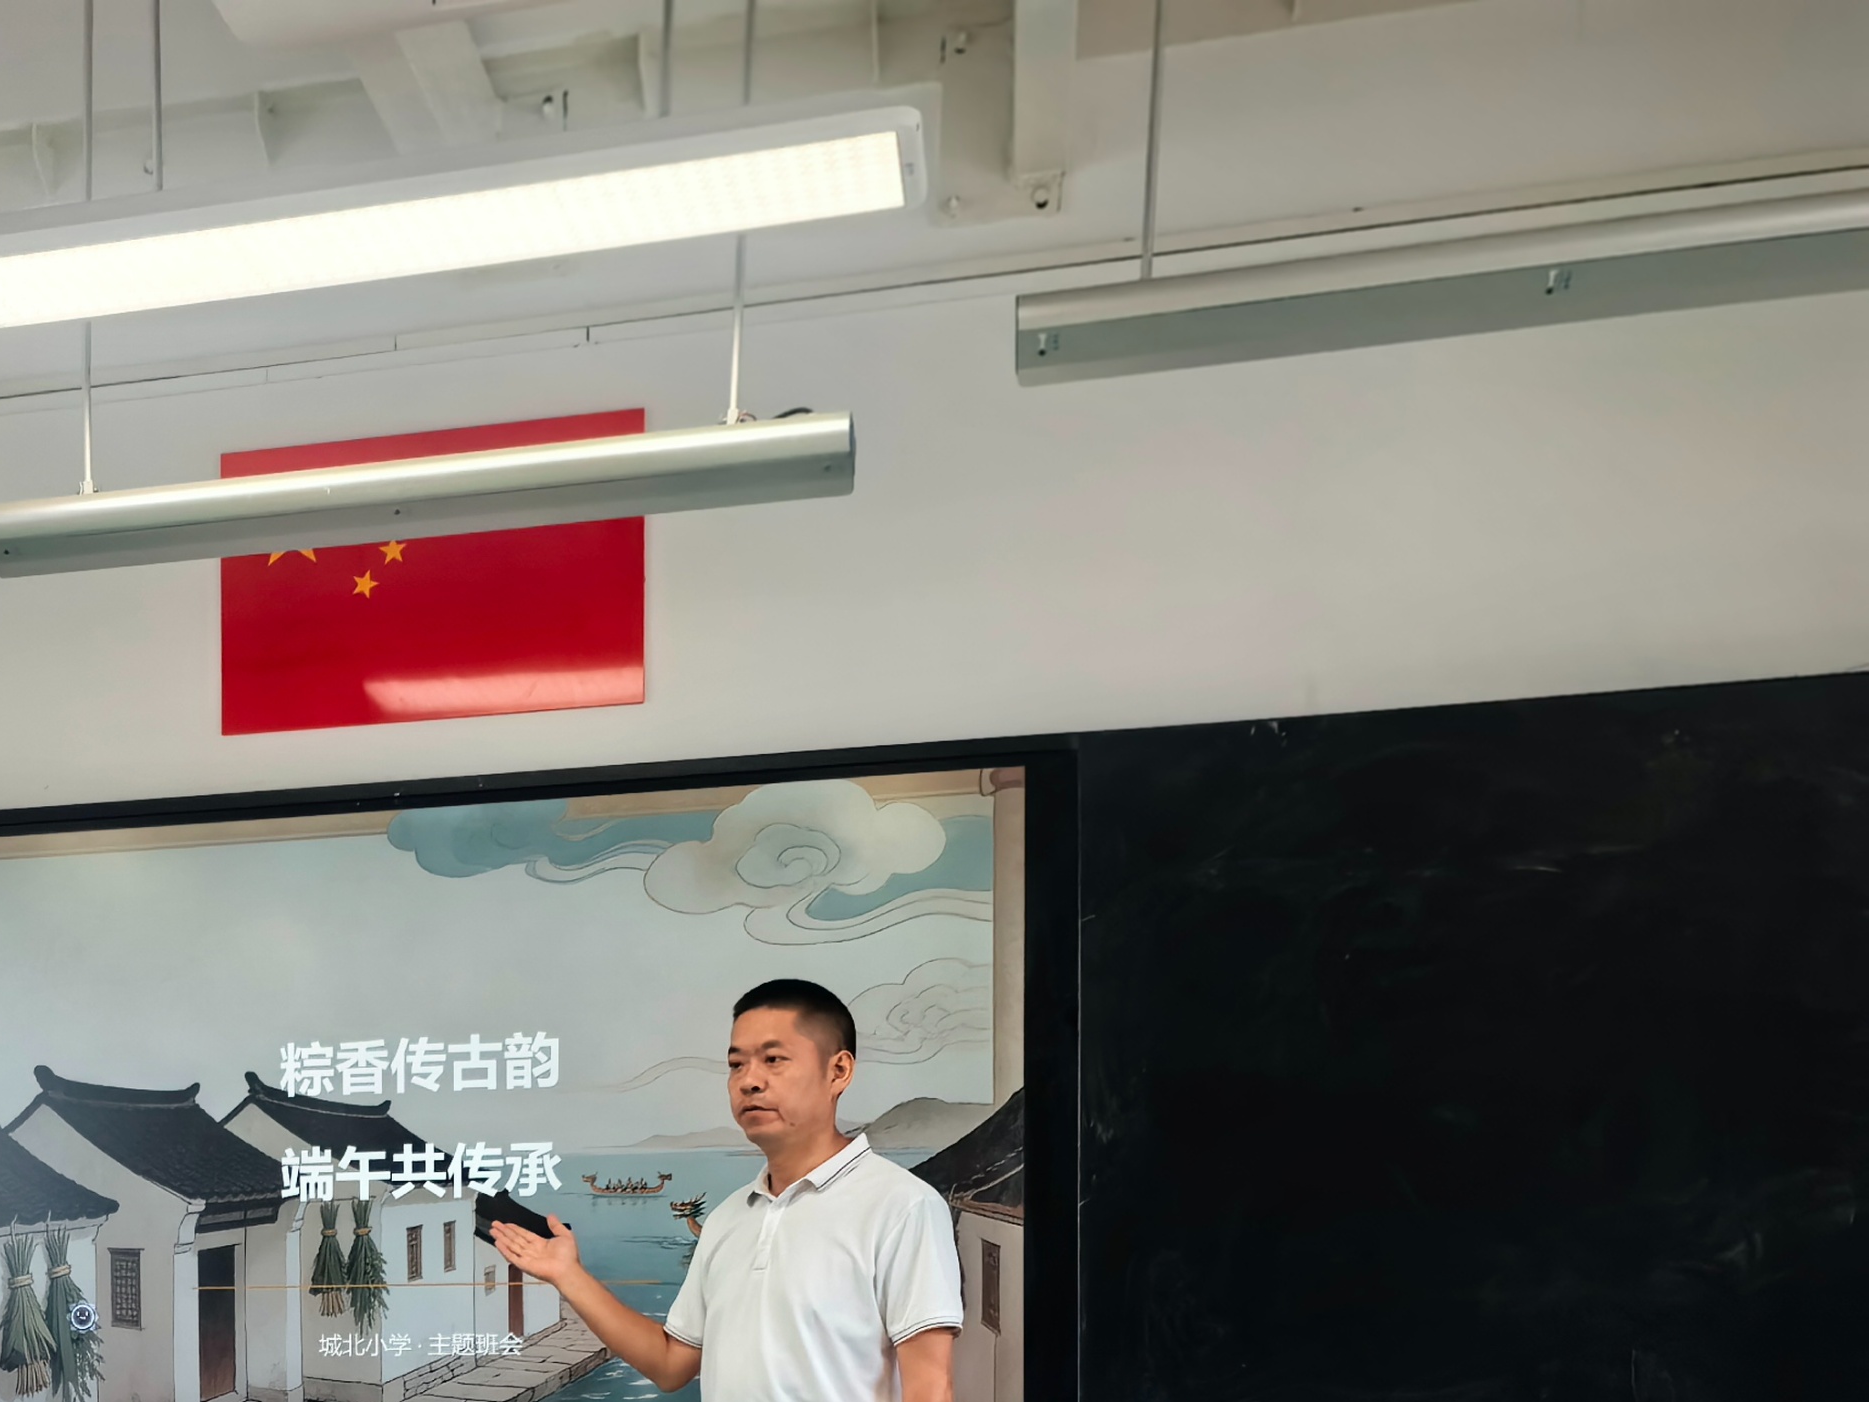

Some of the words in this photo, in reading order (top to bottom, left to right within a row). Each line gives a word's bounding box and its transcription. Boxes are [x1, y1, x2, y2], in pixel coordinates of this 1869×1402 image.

[280, 1031, 560, 1098] 粽香传古韵
[280, 1141, 563, 1202] 端午共传承
